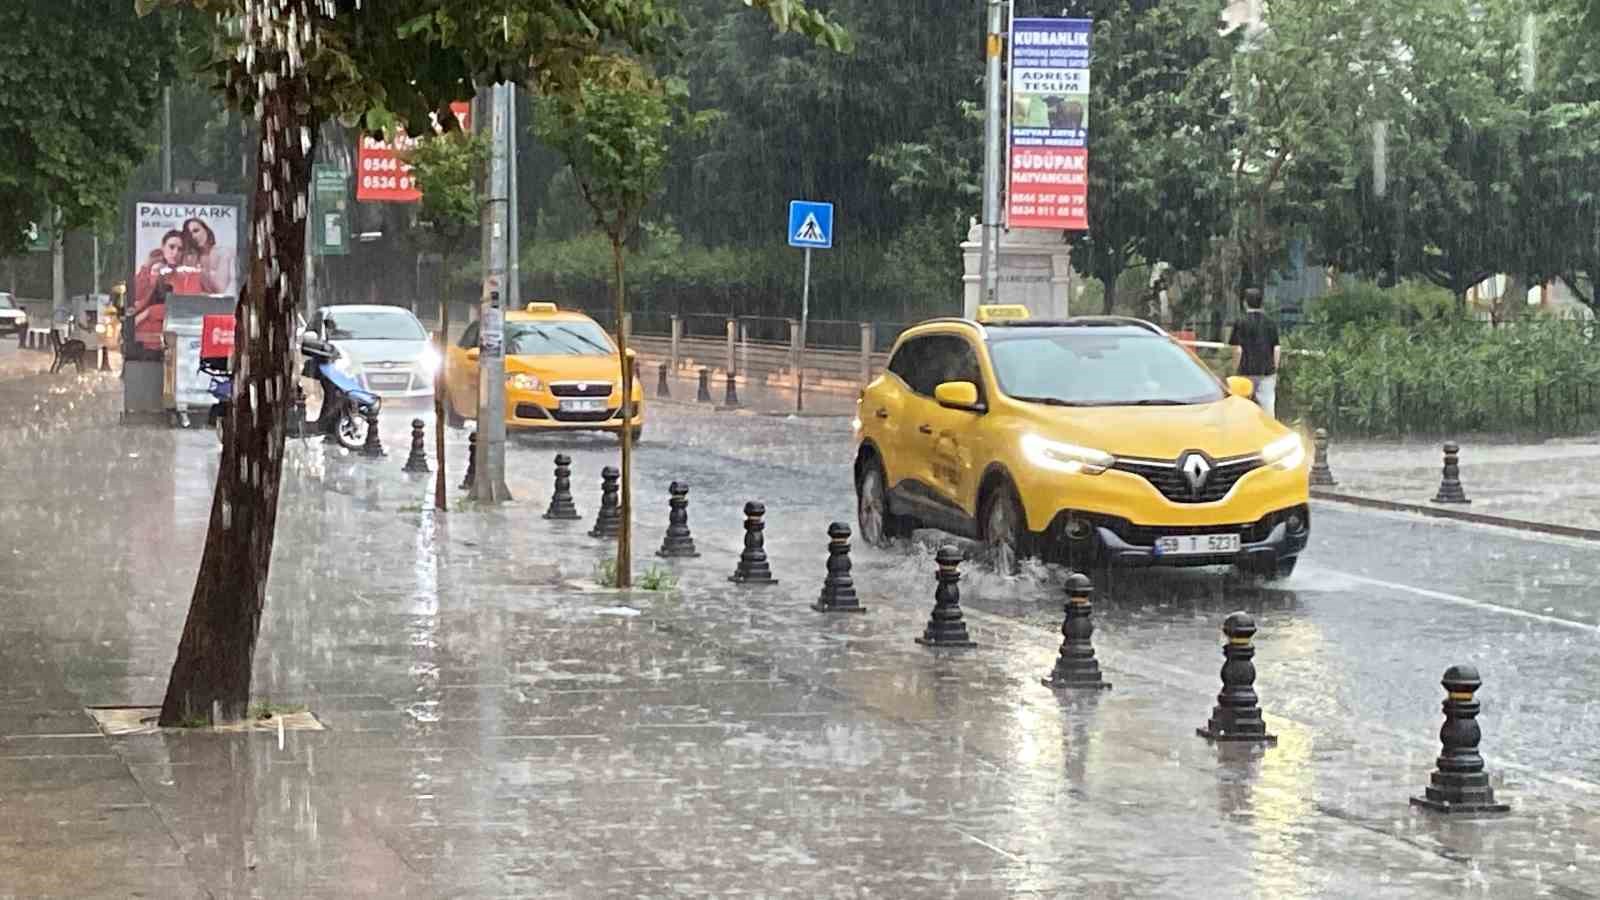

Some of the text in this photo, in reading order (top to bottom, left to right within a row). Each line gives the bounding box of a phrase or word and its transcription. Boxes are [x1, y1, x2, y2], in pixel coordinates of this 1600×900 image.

[1022, 72, 1080, 80] ADRESE
[363, 158, 397, 171] 0544
[1012, 150, 1084, 169] SÜDÜPAK
[363, 175, 397, 189] 0534
[140, 206, 232, 217] PAULMARK
